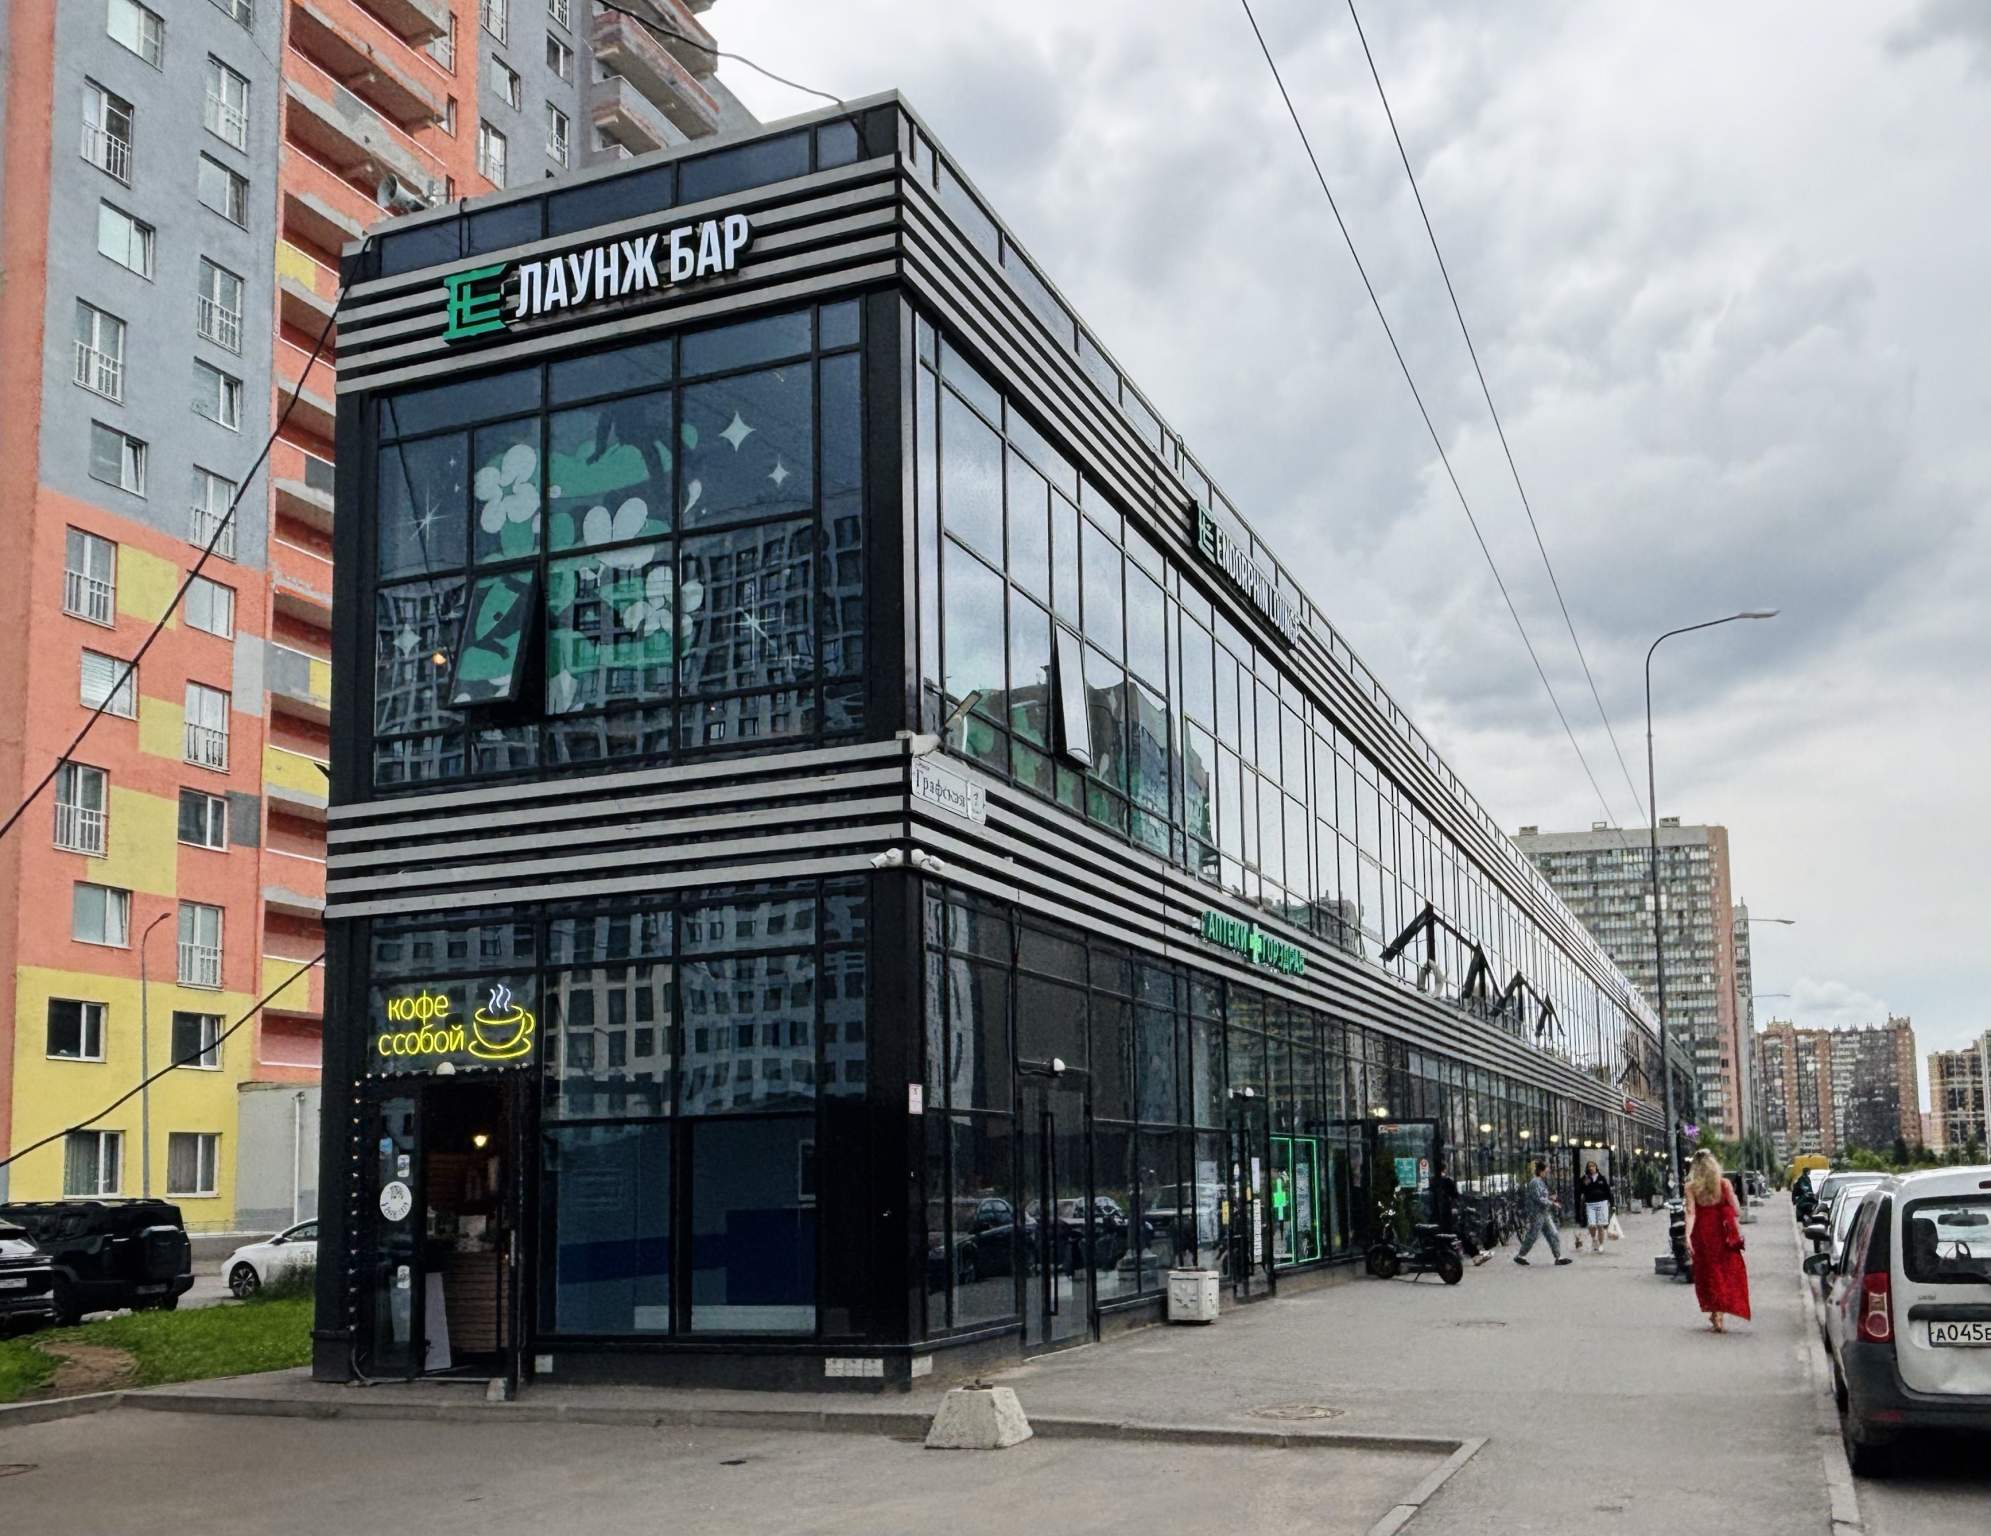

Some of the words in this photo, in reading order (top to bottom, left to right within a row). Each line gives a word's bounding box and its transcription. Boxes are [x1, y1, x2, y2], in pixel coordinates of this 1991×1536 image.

[515, 233, 659, 319] ЛАУНЖ
[670, 213, 749, 283] БАР
[1208, 913, 1248, 953] АПТЕКИ
[388, 989, 450, 1025] кофе
